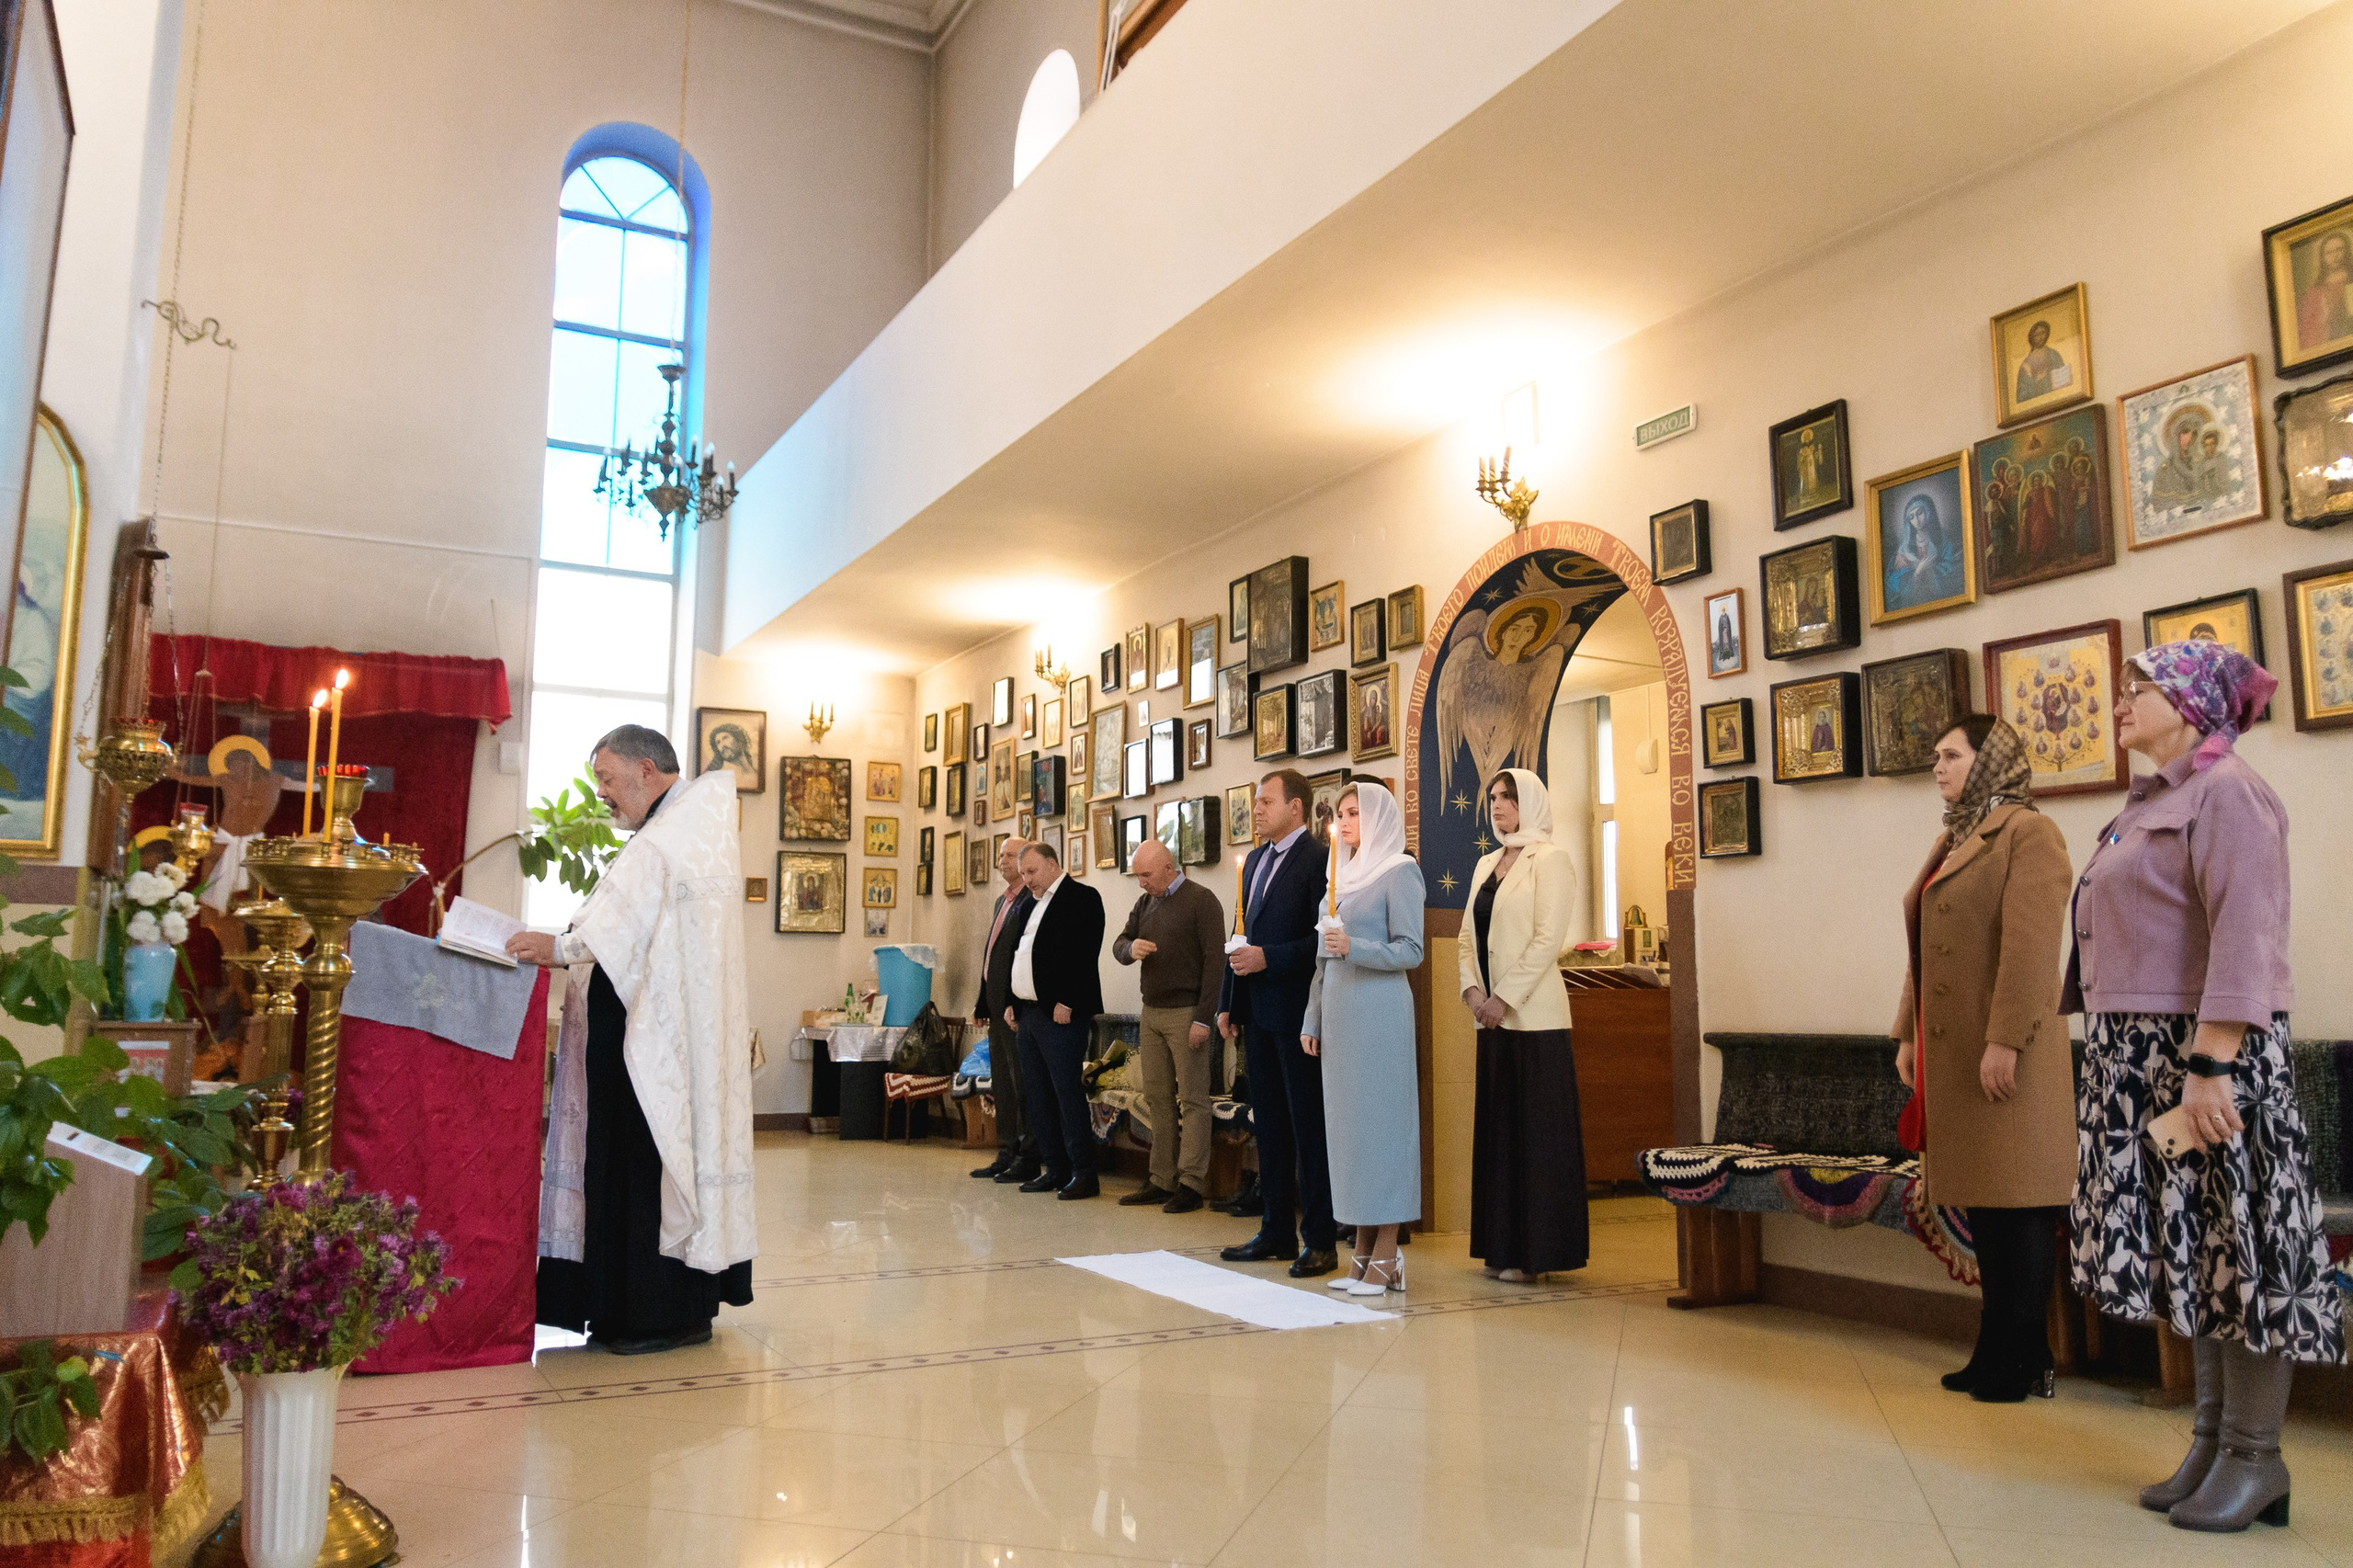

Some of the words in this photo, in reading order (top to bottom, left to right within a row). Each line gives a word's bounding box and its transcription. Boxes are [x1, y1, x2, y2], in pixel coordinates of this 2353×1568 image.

[1639, 411, 1688, 442] ВЫХОД
[1405, 725, 1420, 781] СВЕТЕ
[1523, 528, 1532, 551] И
[1540, 524, 1550, 547] О
